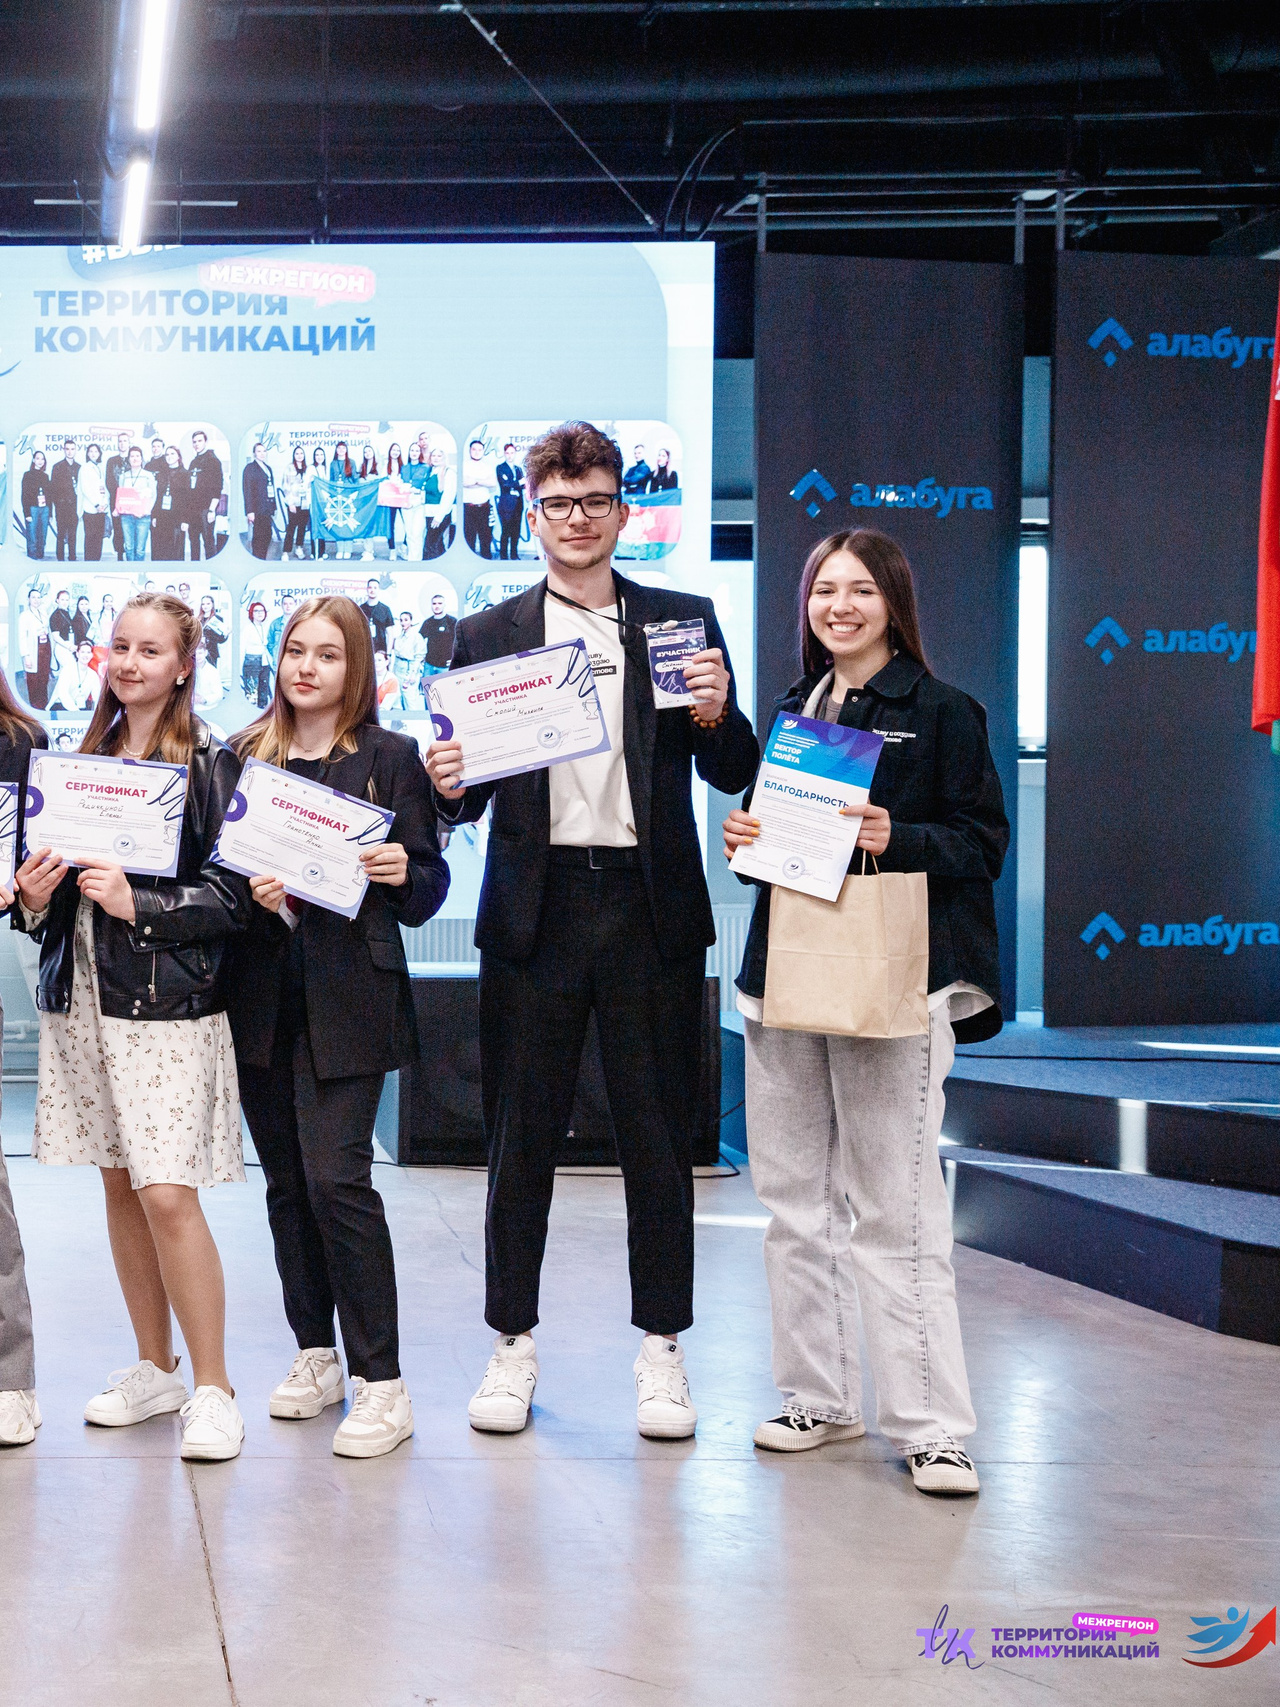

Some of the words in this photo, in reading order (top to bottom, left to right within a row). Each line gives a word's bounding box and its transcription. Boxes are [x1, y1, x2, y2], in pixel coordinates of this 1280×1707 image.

[209, 264, 366, 293] МЕЖРЕГИОН
[34, 289, 288, 317] ТЕРРИТОРИЯ
[34, 317, 376, 356] КОММУНИКАЦИЙ
[850, 476, 994, 518] алабуга
[468, 675, 553, 704] СЕРТИФИКАТ
[65, 781, 148, 798] СЕРТИФИКАТ
[271, 797, 350, 833] СЕРТИФИКАТ
[1138, 914, 1280, 955] алабуга
